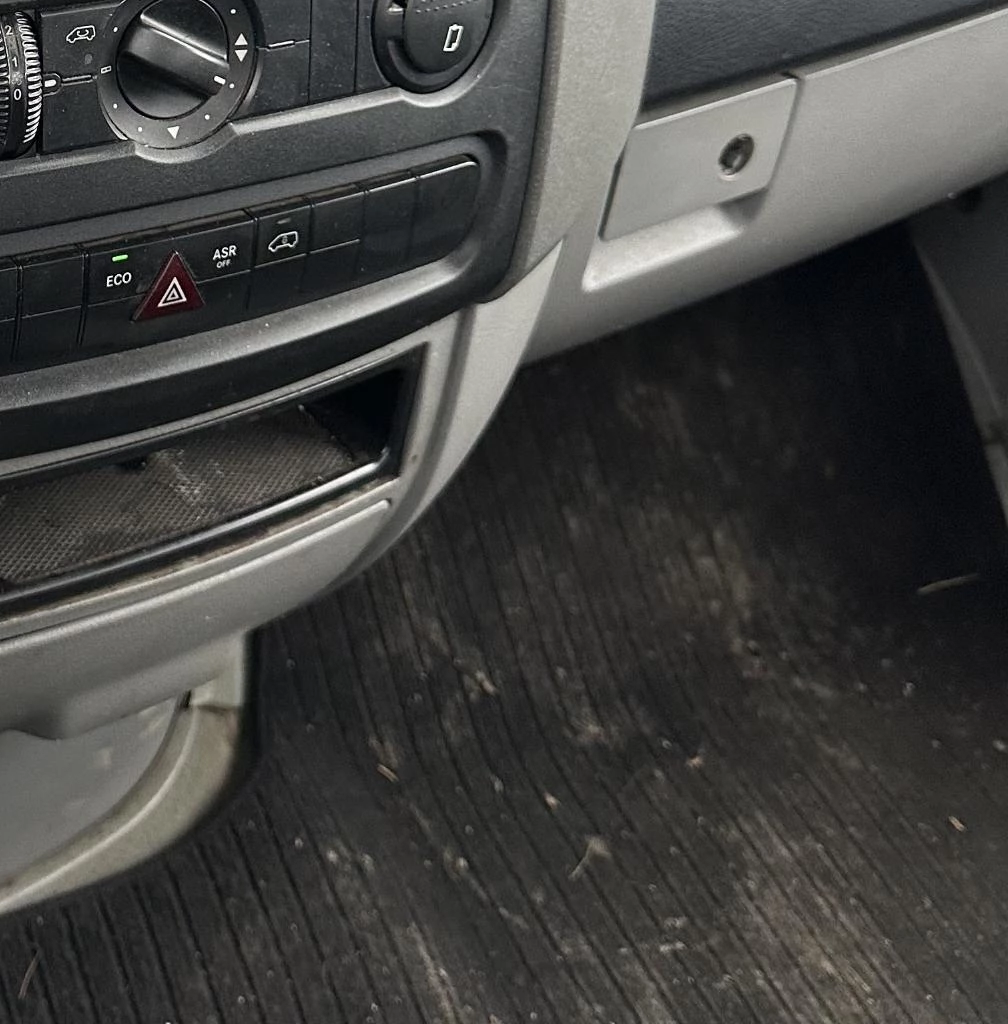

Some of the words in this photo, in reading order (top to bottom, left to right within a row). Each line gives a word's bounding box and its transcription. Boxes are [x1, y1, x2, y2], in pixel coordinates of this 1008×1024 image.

[4, 24, 13, 36] 2
[13, 88, 22, 101] 0
[212, 244, 237, 260] ASR
[216, 258, 231, 269] OFF
[105, 271, 132, 288] ECO
